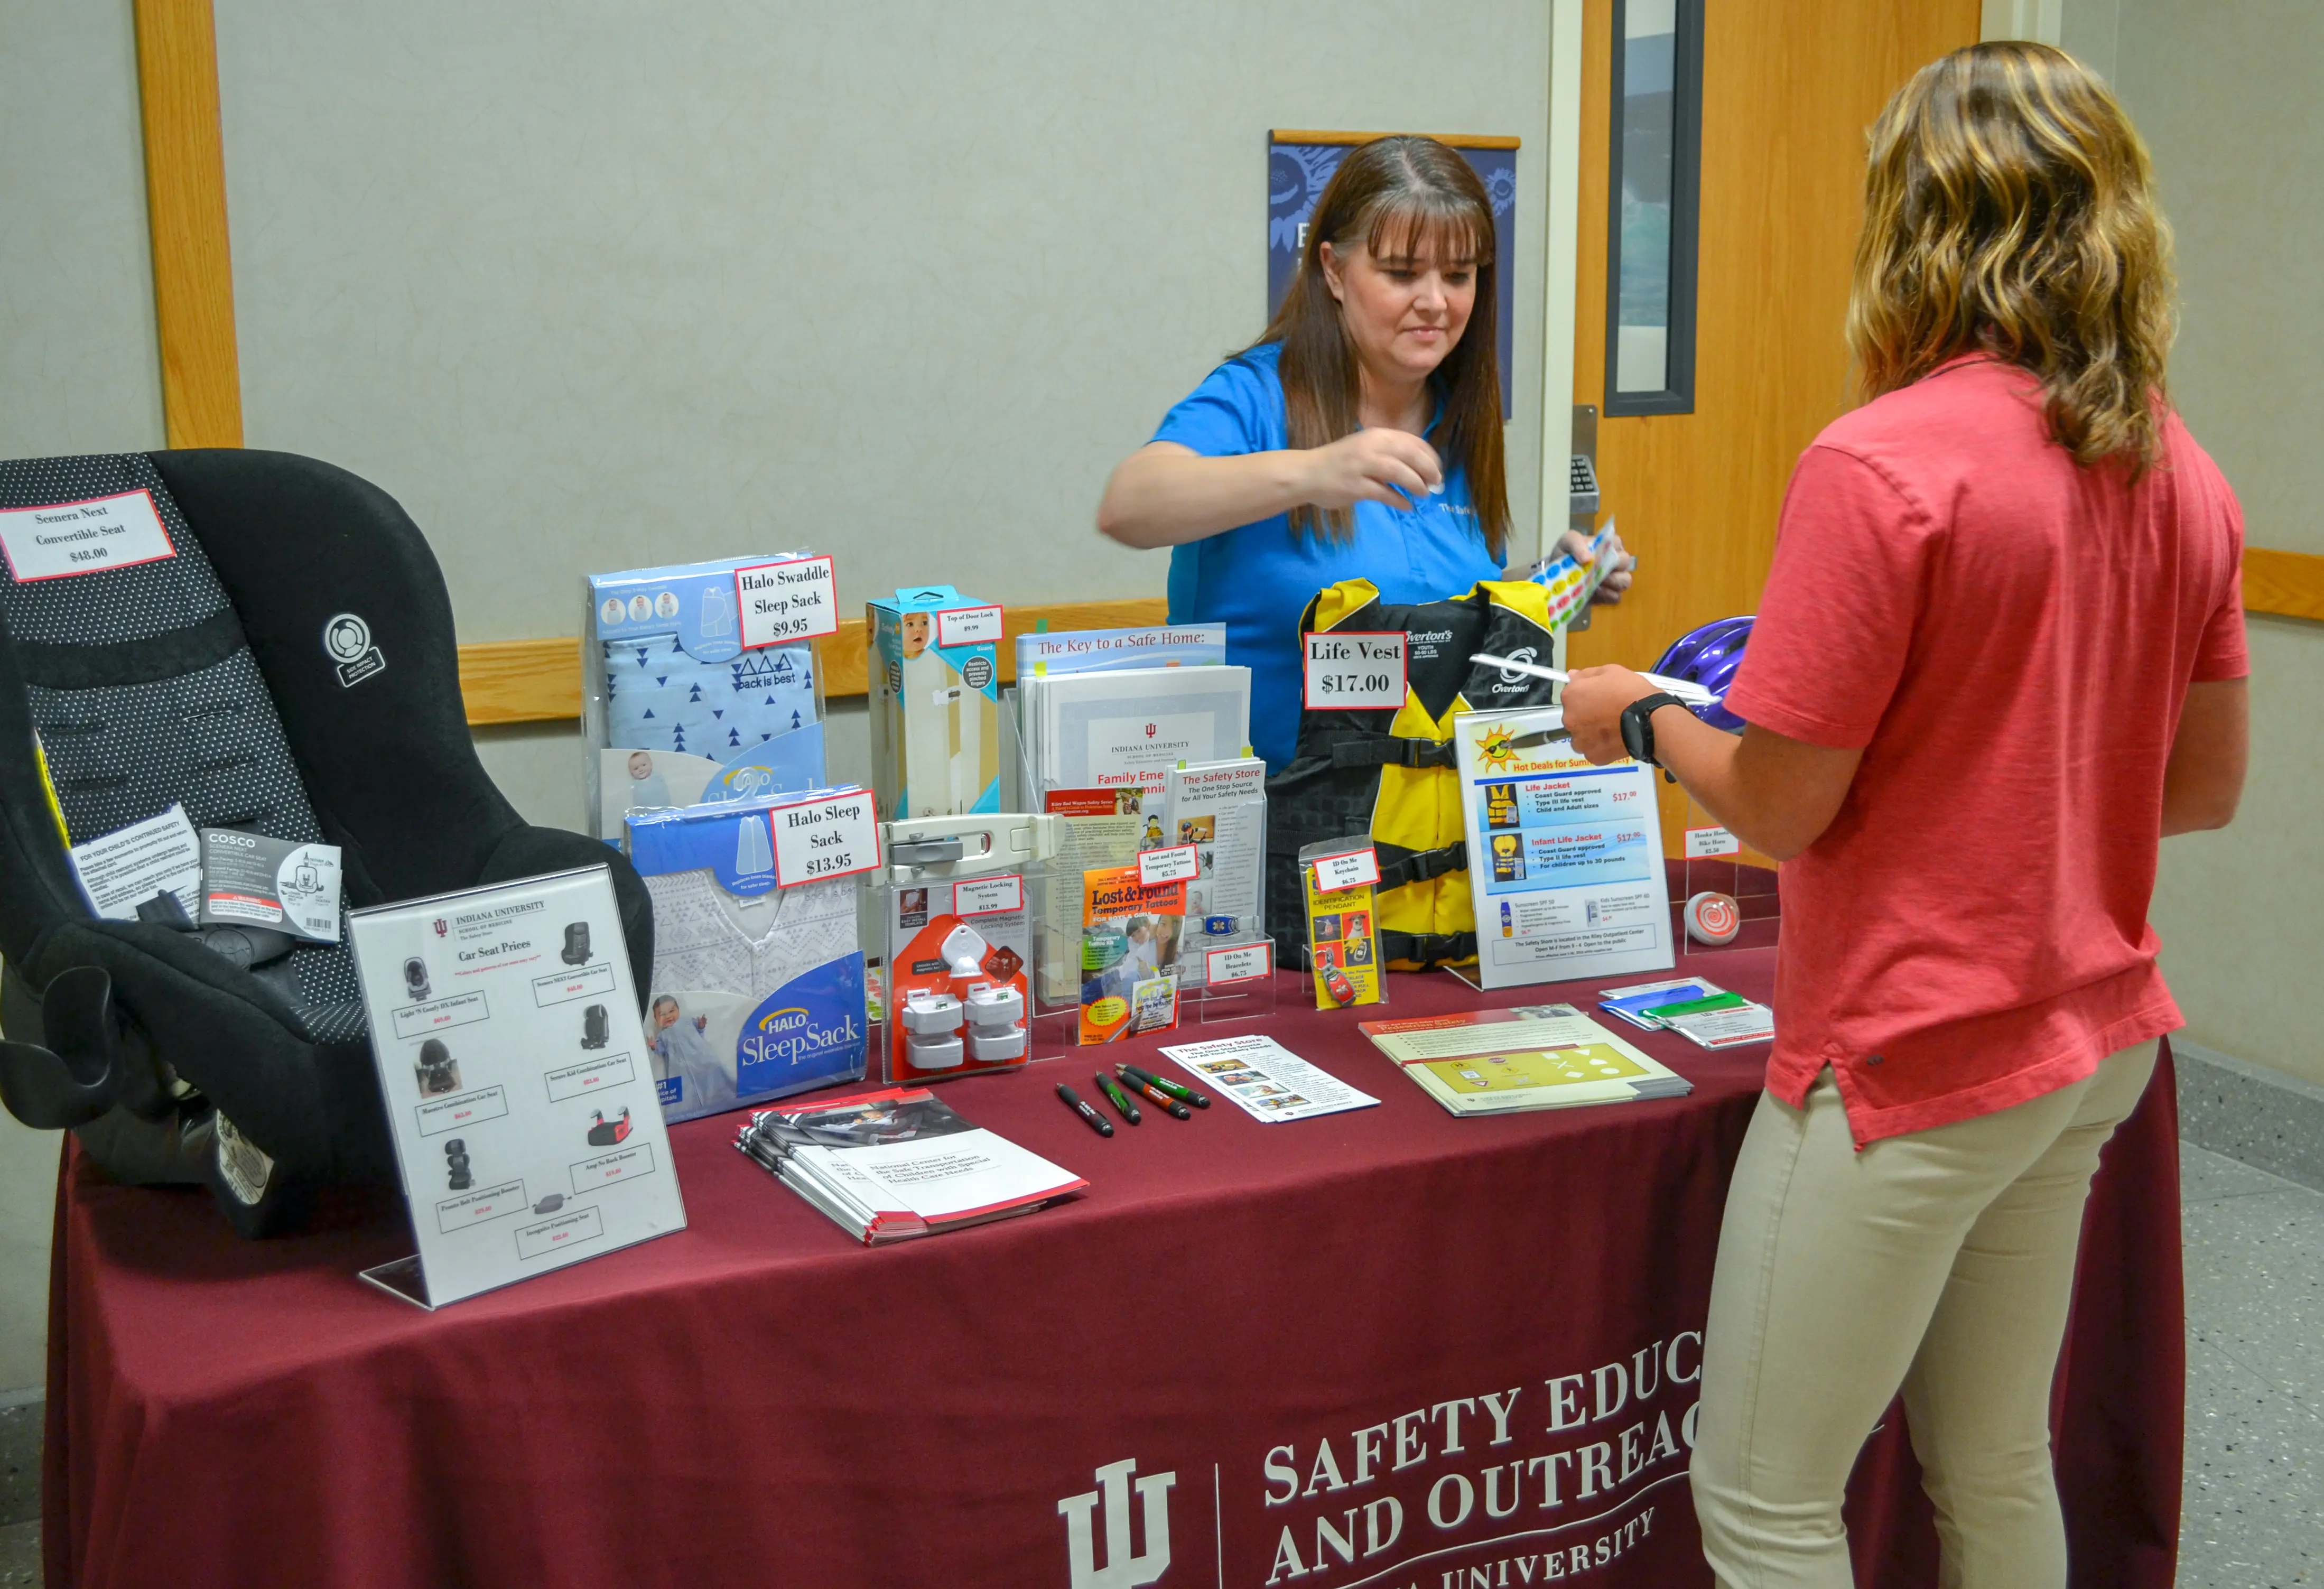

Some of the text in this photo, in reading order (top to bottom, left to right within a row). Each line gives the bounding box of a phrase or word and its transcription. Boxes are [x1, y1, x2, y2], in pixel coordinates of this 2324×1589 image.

[35, 507, 108, 524] Scenera Next
[36, 525, 126, 545] Convertible Seat
[70, 548, 108, 563] $48.00
[741, 565, 830, 590] Halo Swaddle
[755, 591, 822, 615] Sleep Sack
[773, 618, 808, 637] $9.95
[1038, 631, 1205, 655] The Key to a Safe Home:
[1310, 642, 1350, 660] Life
[1356, 641, 1401, 659] Vest
[774, 672, 796, 685] best
[1322, 674, 1389, 694] $17.00
[1492, 683, 1530, 693] Overton's
[1145, 741, 1189, 750] UNIVERSITY
[1513, 759, 1567, 772] Hot Deals for
[1098, 771, 1164, 785] Family Eme
[1183, 769, 1260, 785] The Safety Store
[1543, 782, 1570, 791] Jacket
[1574, 788, 1602, 796] approved
[1217, 791, 1237, 801] Safety
[787, 805, 860, 828] Halo Sleep
[80, 821, 180, 862] FOR YOUR CHILD'S CONTINUED SAFETY
[209, 834, 256, 848] COSCO
[811, 831, 843, 849] Sack
[1557, 835, 1573, 844] Life
[1575, 833, 1602, 842] Jacket
[1578, 843, 1605, 852] approved
[806, 853, 852, 876] $13.95
[1145, 862, 1172, 871] Temporary
[1335, 866, 1359, 875] Keychain
[963, 885, 988, 893] Magnetic
[1092, 898, 1178, 915] Temporary Tattoos
[1313, 894, 1364, 905] IDENTIFICATION
[1324, 902, 1356, 910] PENDANT
[456, 900, 545, 925] INDIANA UNIVERSITY
[459, 941, 531, 962] Car Seat Prices
[1225, 961, 1252, 970] Bracelets
[768, 1014, 806, 1034] HALO
[742, 1014, 861, 1066] SleepSack
[914, 1155, 980, 1170] Transportation
[957, 1157, 991, 1169] Special
[888, 1176, 920, 1184] Health
[944, 1166, 974, 1176] Needs
[1265, 1330, 1702, 1507] SAFETY EDUC
[1265, 1494, 1403, 1586] AND
[1442, 1506, 1655, 1589] UNIVERSITY
